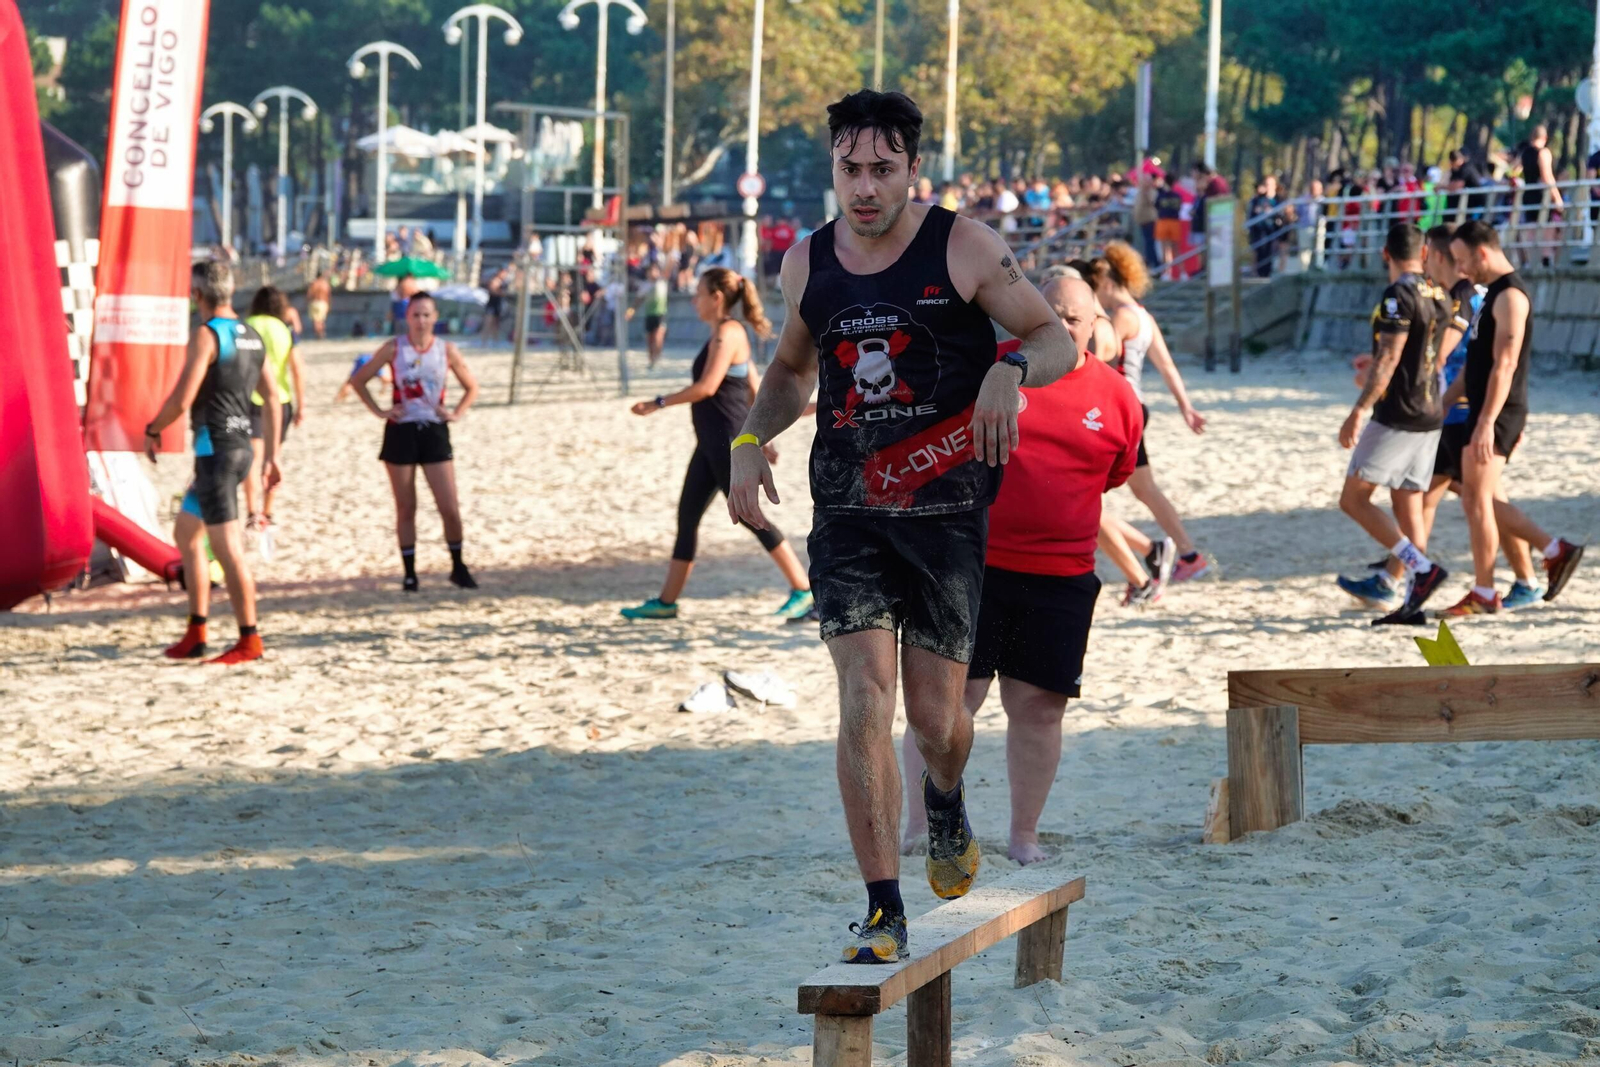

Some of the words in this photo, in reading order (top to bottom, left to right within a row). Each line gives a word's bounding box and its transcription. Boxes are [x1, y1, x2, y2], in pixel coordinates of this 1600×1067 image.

[155, 30, 178, 109] VIGO
[123, 6, 158, 188] CONCELLO
[151, 126, 170, 168] DE
[1009, 271, 1018, 280] 12
[916, 298, 950, 306] MARCET
[840, 315, 899, 328] CROSS
[832, 403, 938, 429] X-ONE
[876, 426, 970, 491] X-ONE
